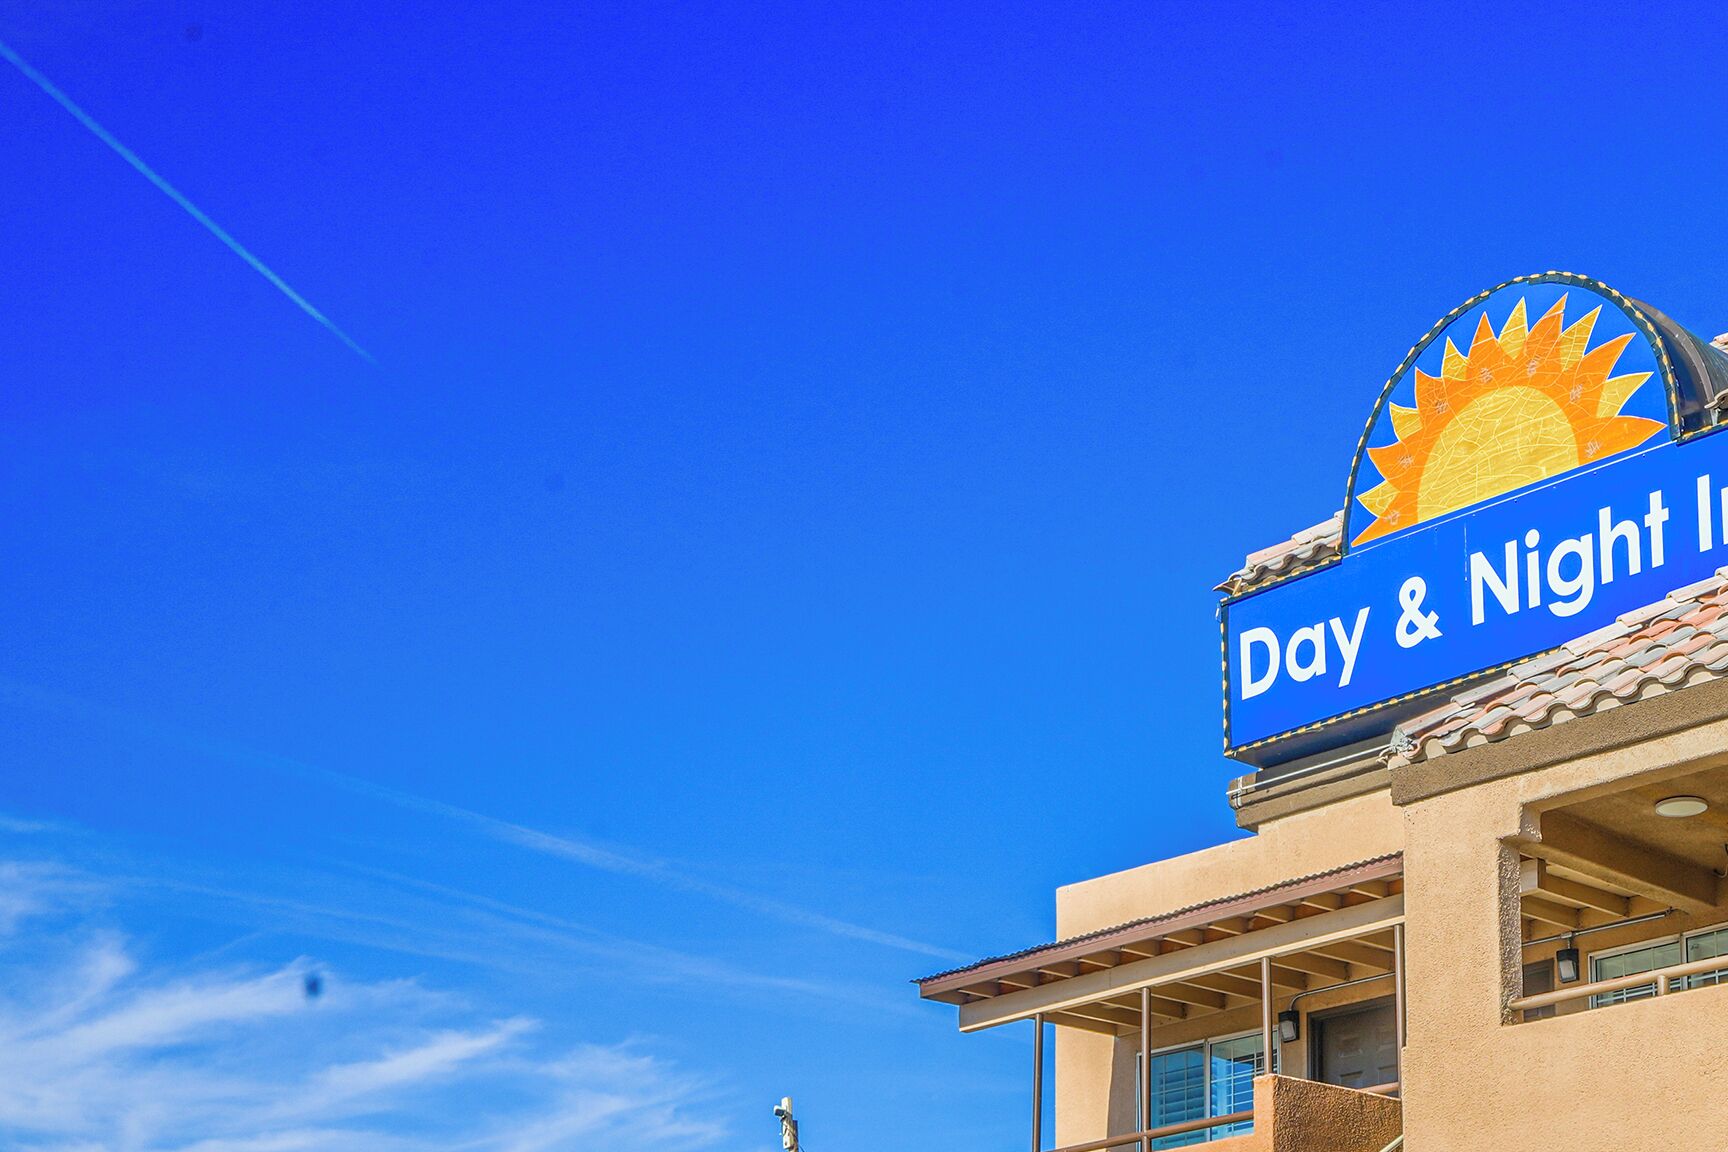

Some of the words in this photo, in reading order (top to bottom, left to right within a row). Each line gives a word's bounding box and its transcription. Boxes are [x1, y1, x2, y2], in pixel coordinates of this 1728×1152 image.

[1239, 605, 1371, 701] Day
[1395, 575, 1443, 650] &
[1470, 489, 1670, 626] Night
